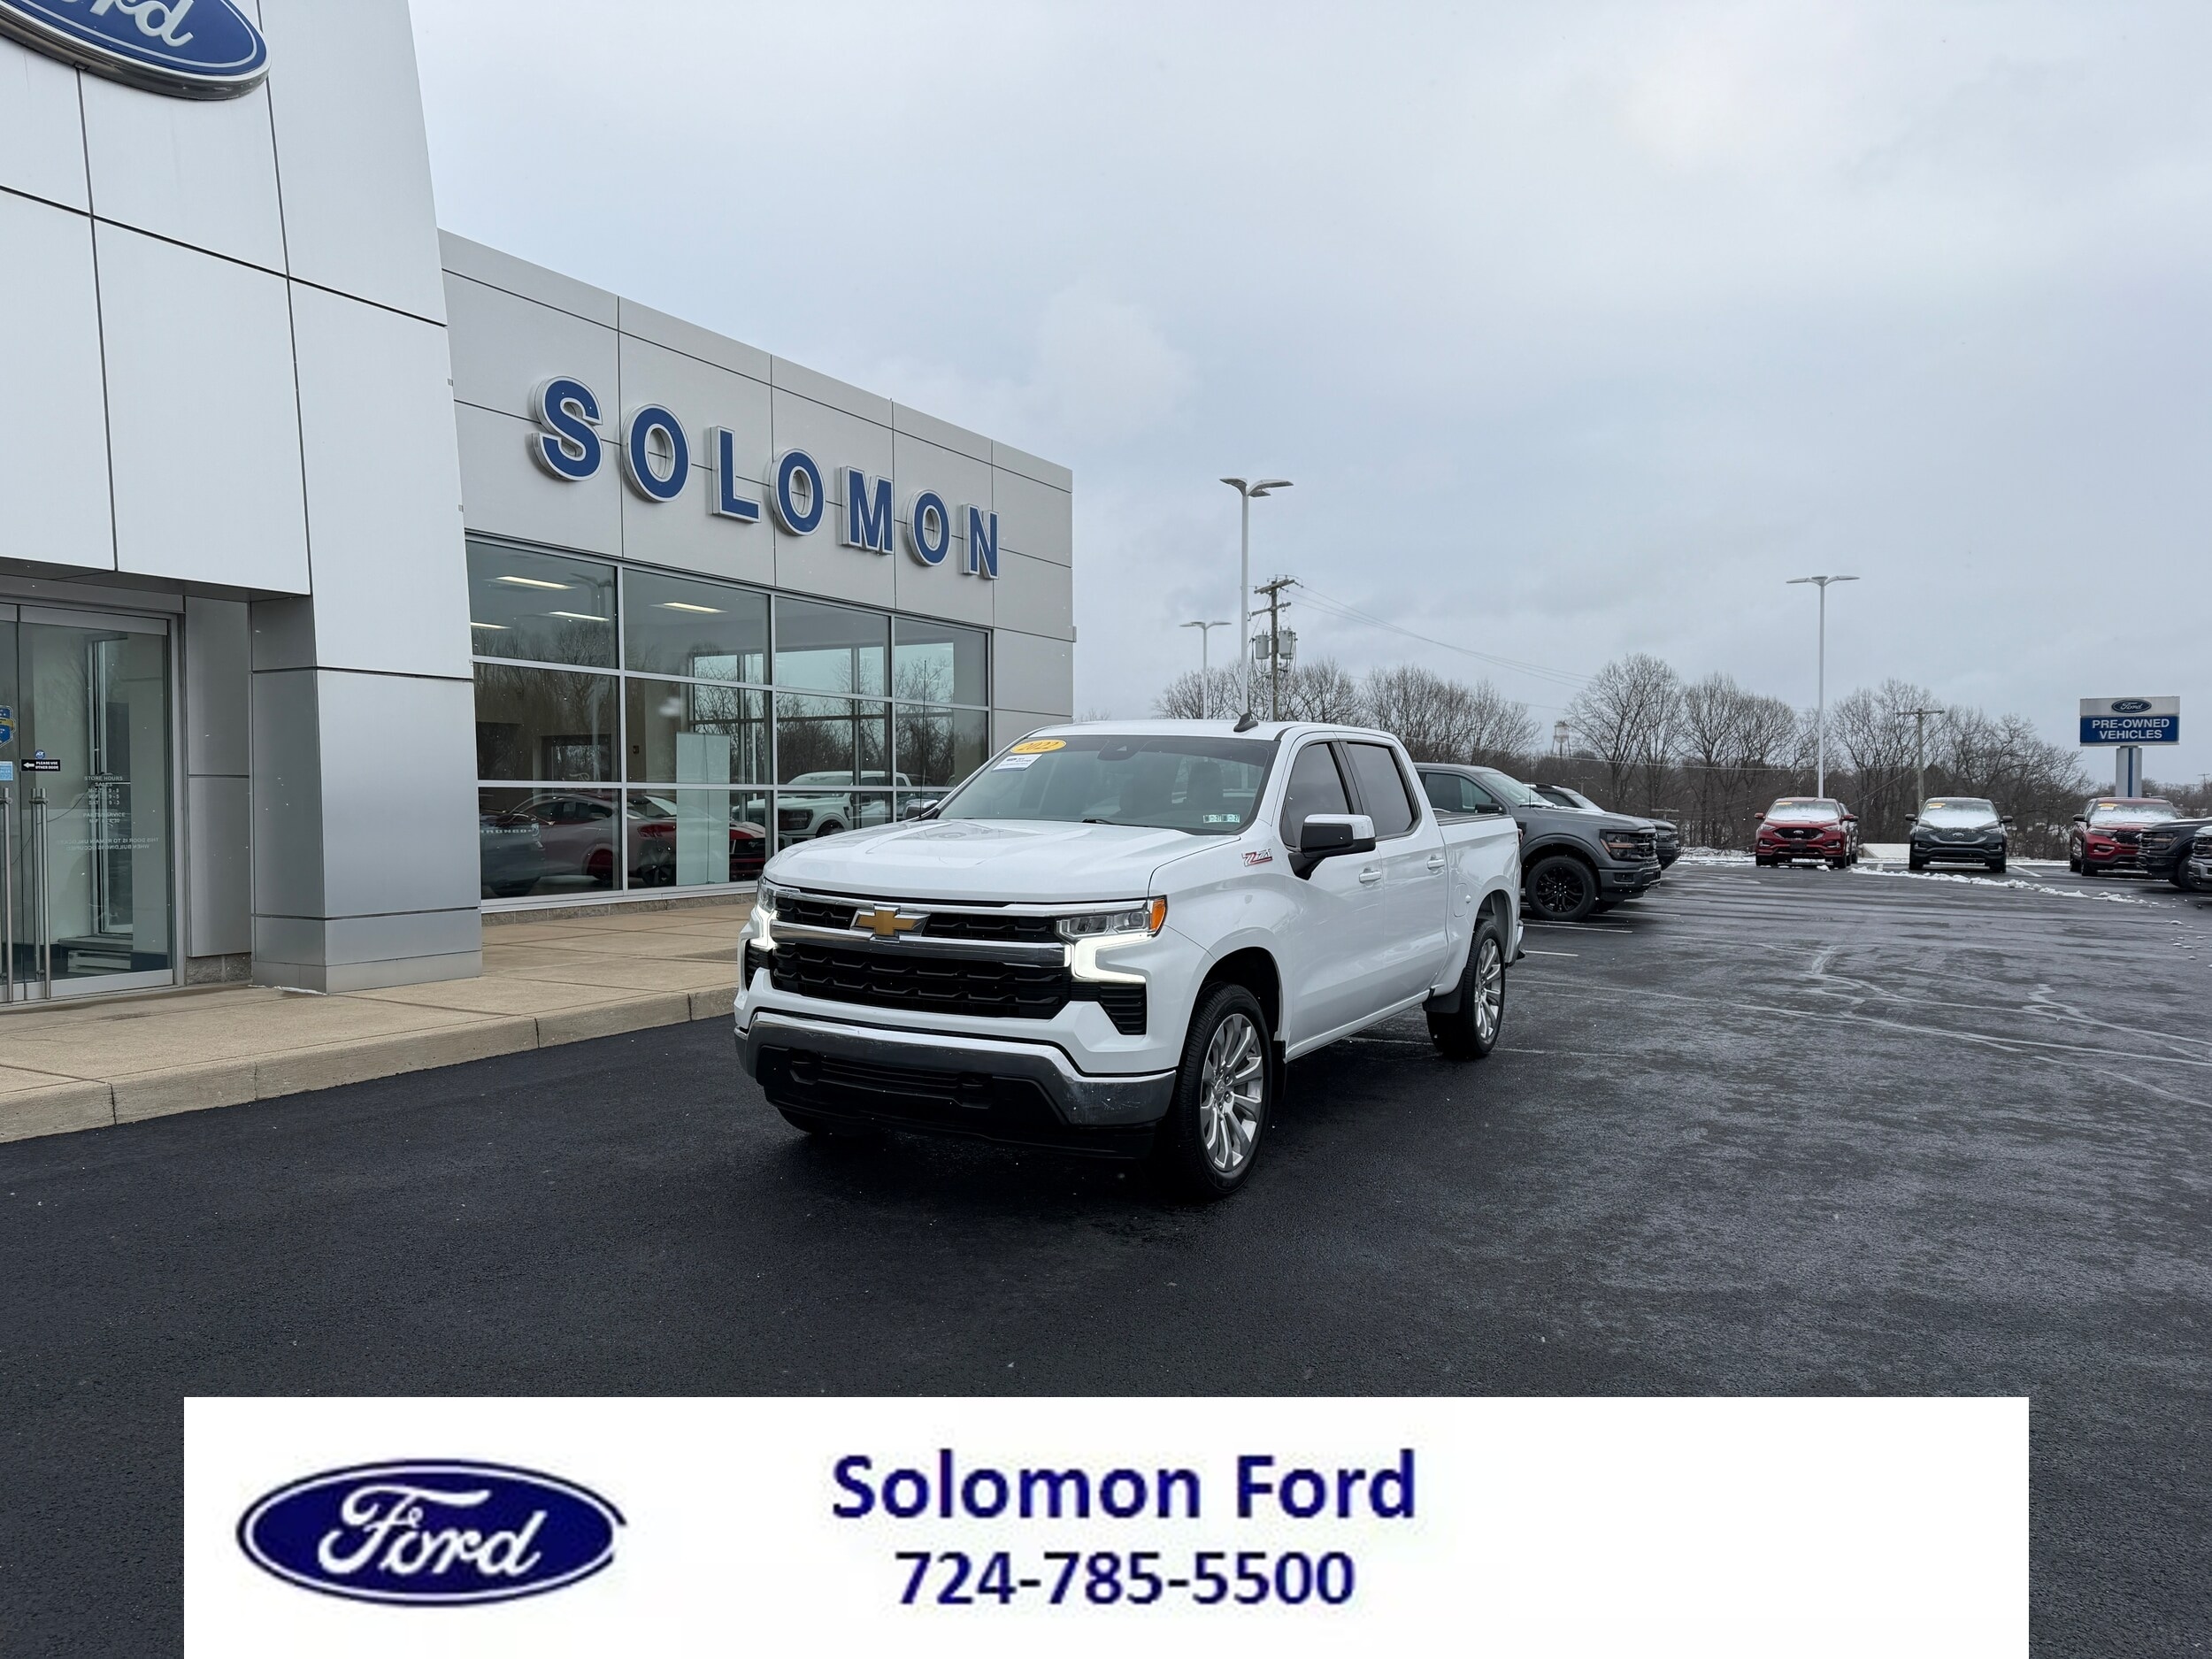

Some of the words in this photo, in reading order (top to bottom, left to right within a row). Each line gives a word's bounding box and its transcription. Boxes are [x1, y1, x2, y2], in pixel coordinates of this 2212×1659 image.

[533, 375, 1000, 580] SOLOMON
[2120, 702, 2143, 710] Ford
[2092, 718, 2170, 729] PRE-OWNED
[2099, 729, 2162, 740] VEHICLES
[1241, 849, 1272, 867] Z71
